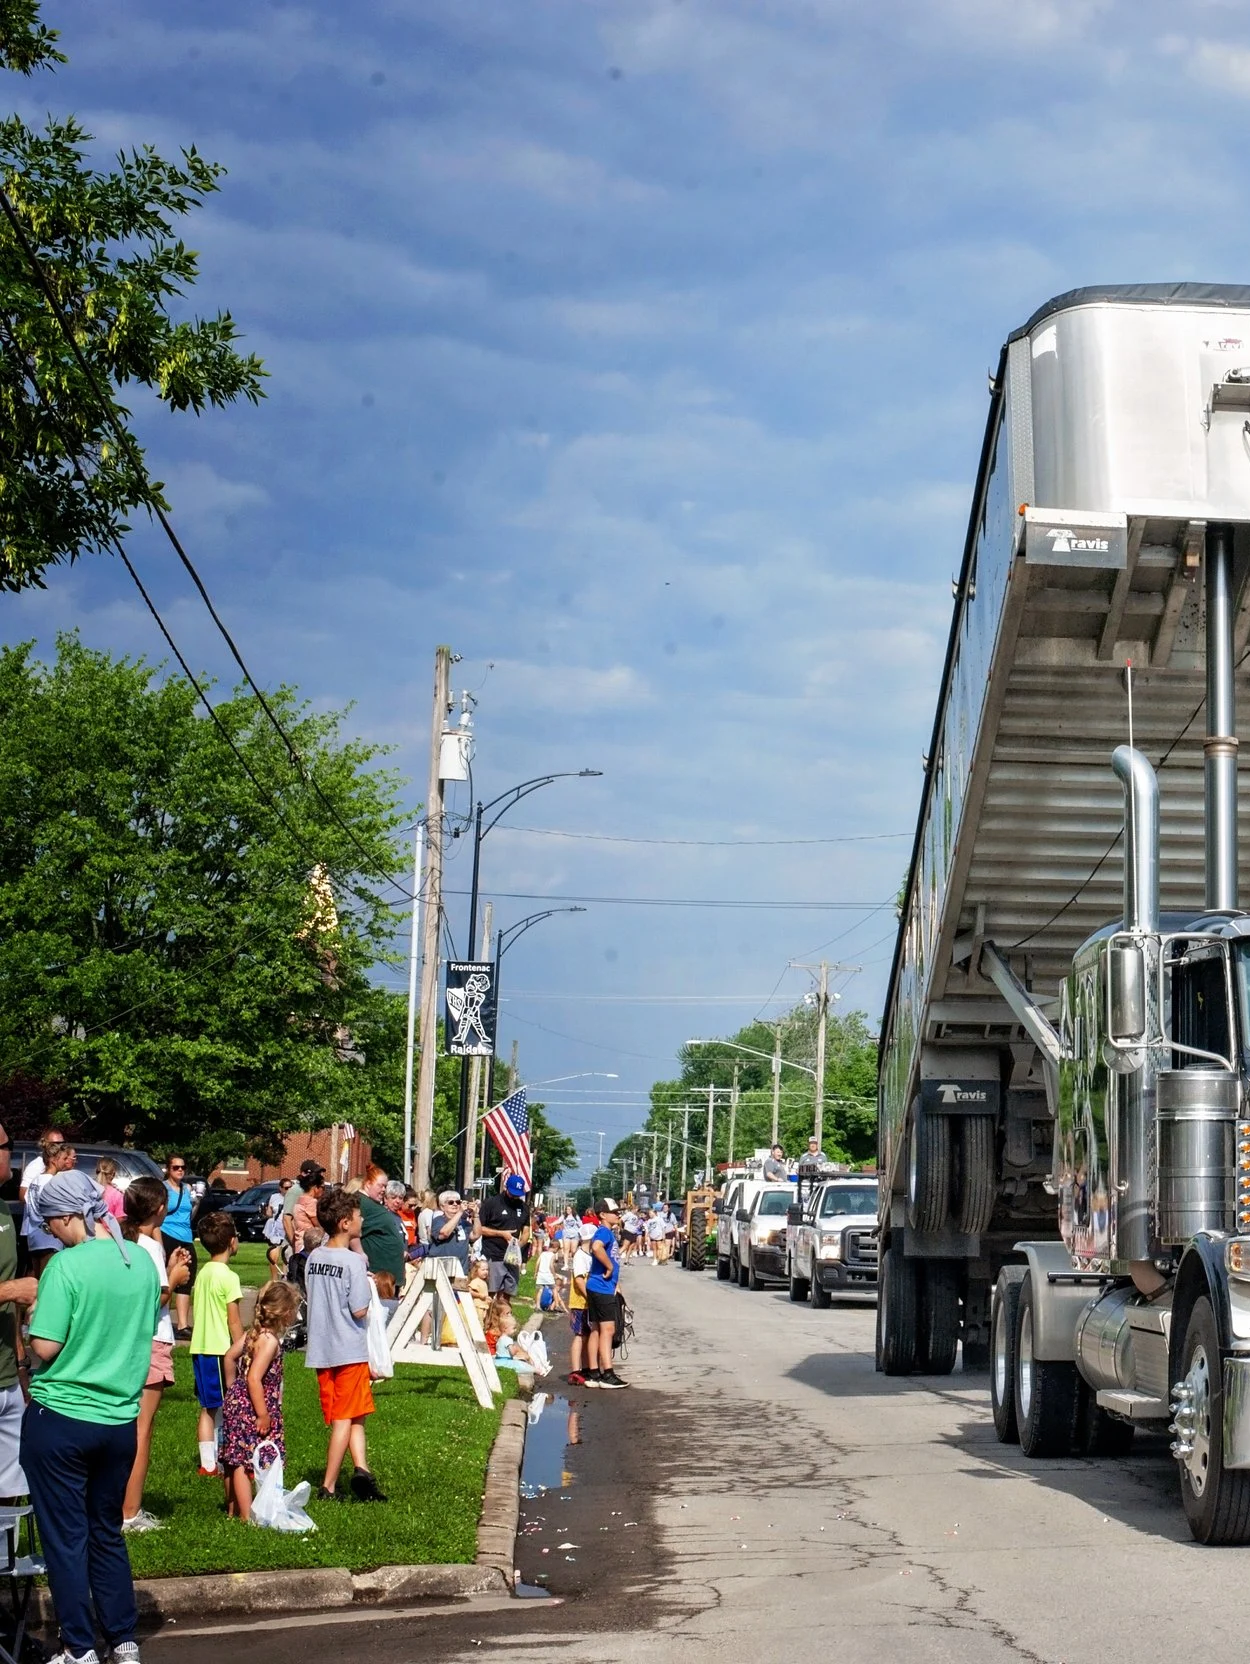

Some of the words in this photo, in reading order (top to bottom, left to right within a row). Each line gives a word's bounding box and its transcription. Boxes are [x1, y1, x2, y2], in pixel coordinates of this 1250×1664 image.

[1045, 528, 1109, 552] Travis
[450, 963, 491, 972] Frontenac
[936, 1084, 987, 1103] Travis
